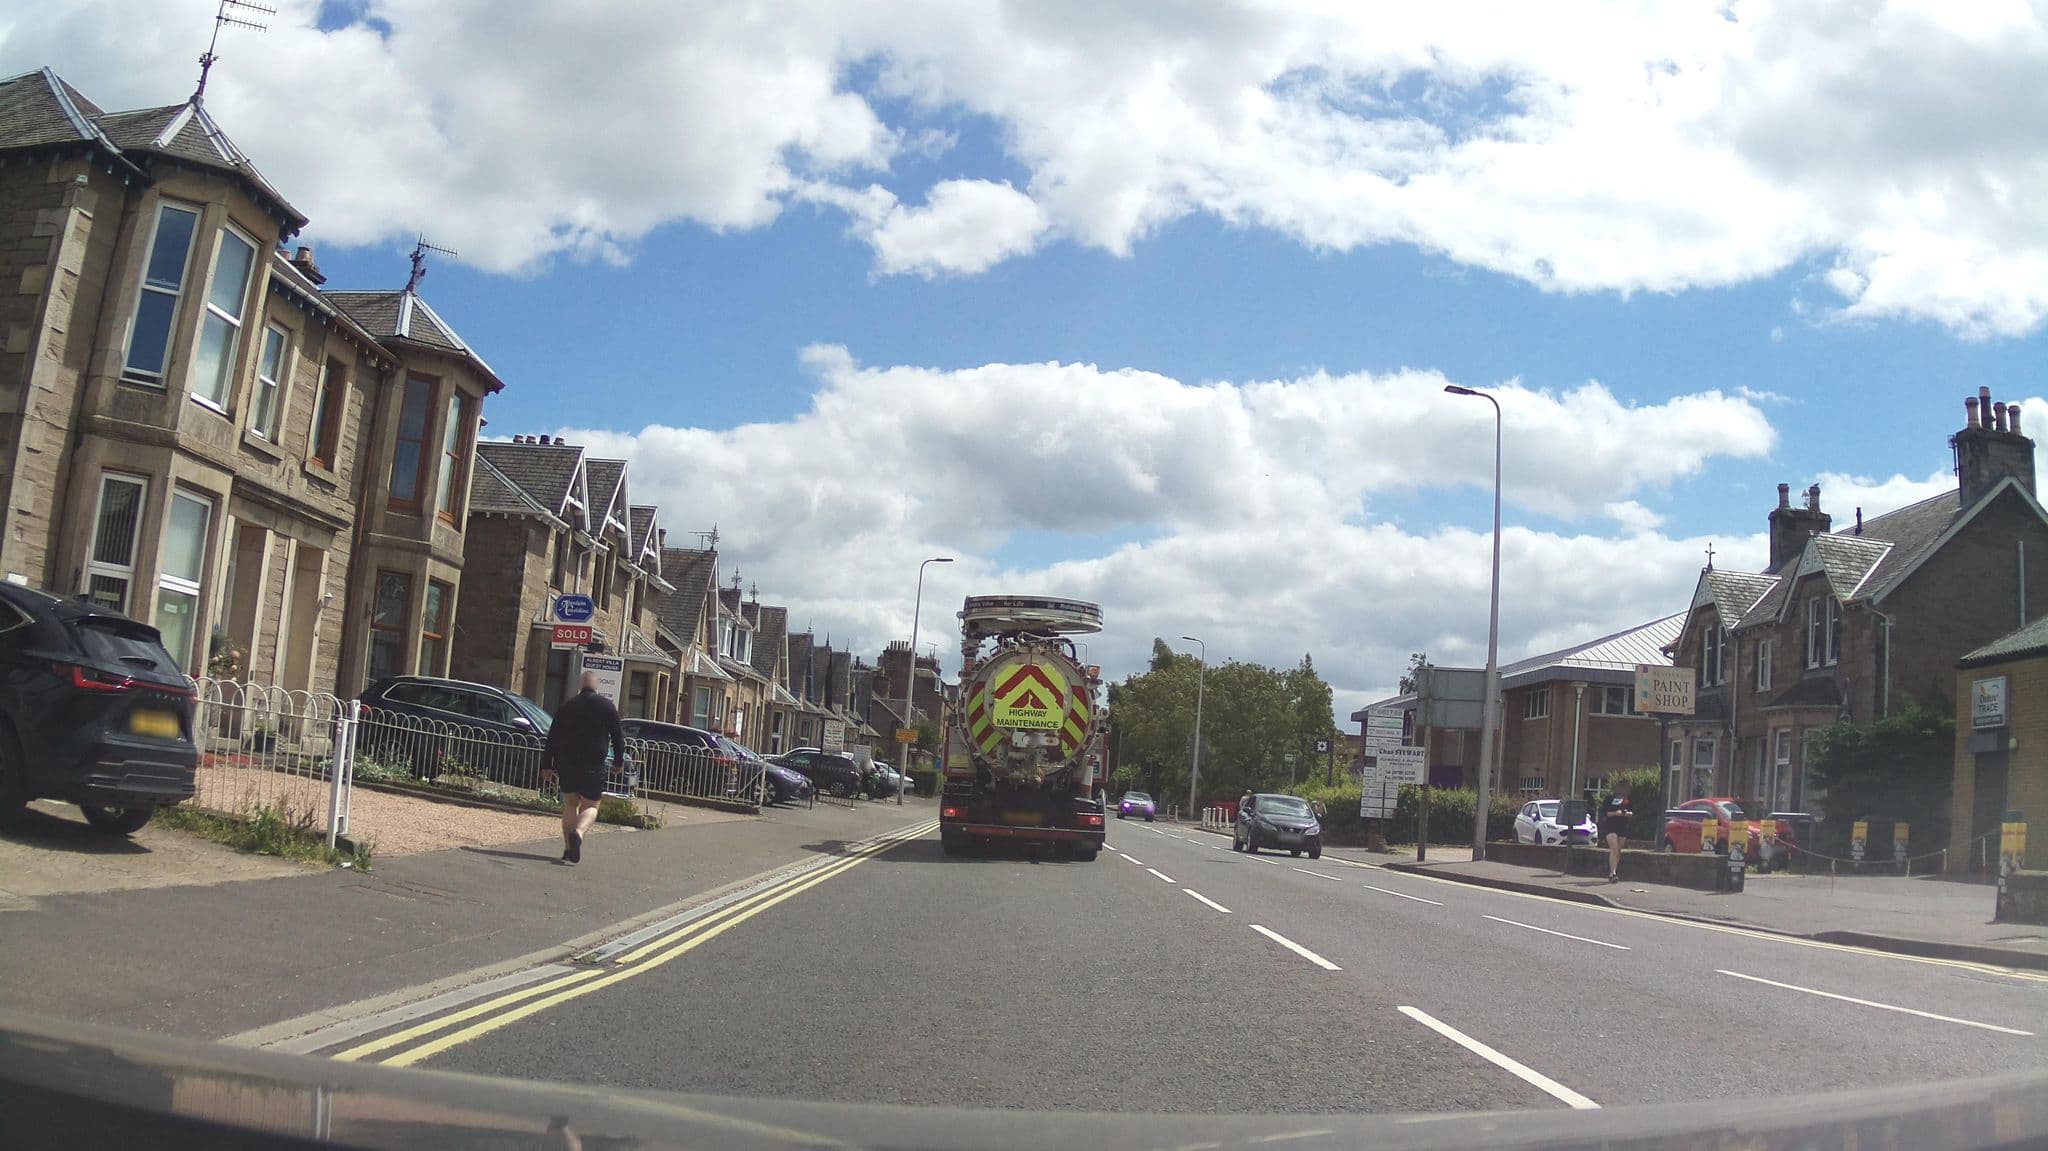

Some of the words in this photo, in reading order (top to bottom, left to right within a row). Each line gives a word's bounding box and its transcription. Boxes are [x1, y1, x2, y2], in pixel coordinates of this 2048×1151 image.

[557, 629, 588, 640] SOLD
[1653, 679, 1689, 693] PAINT
[1655, 695, 1688, 707] SHOP
[1979, 694, 1997, 703] Dulux
[1978, 703, 1998, 712] TRADE
[1008, 708, 1048, 718] HIGHWAY
[996, 718, 1059, 729] MAINTENANCE
[1395, 749, 1424, 757] STEWART
